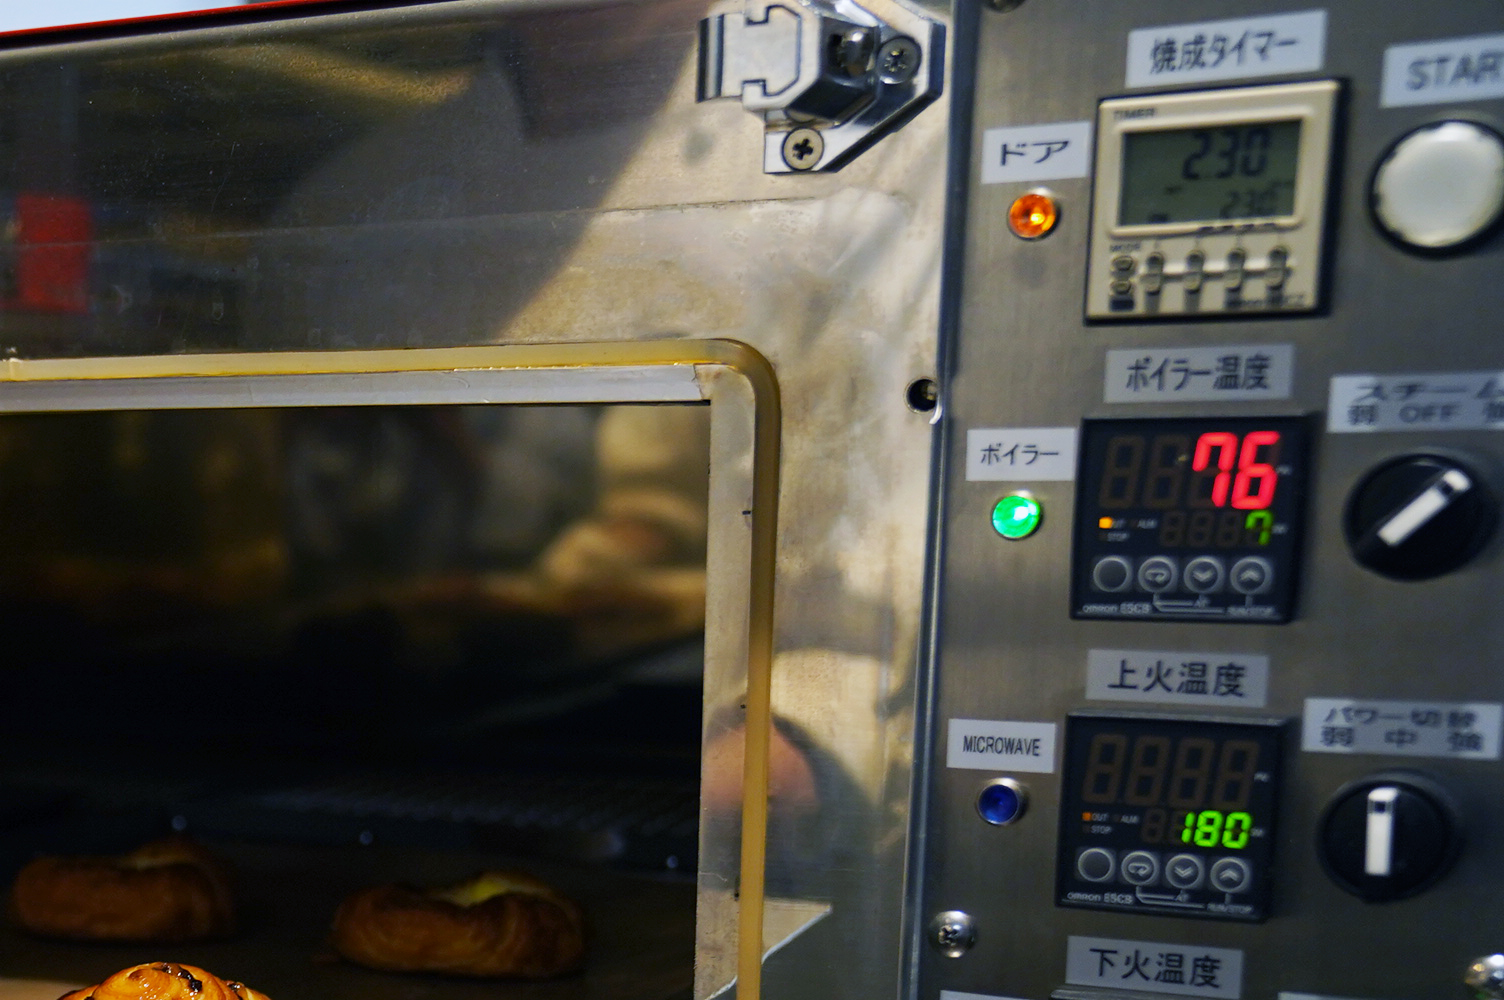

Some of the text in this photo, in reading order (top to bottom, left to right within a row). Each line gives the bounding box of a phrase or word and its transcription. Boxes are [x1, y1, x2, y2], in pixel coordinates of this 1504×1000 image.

[1150, 30, 1300, 73] 焼成タイマー
[1406, 51, 1504, 91] STAR
[1001, 140, 1069, 167] ドア
[1127, 354, 1271, 391] ボイラー温度
[1399, 403, 1461, 423] OFF
[980, 443, 1059, 467] ボイラー
[1192, 430, 1281, 510] 76
[1245, 509, 1274, 546] 7
[1107, 660, 1247, 697] 上火温度
[963, 735, 1041, 757] MICROWAVE
[1181, 810, 1252, 849] 180
[1090, 948, 1221, 988] 下火温度
